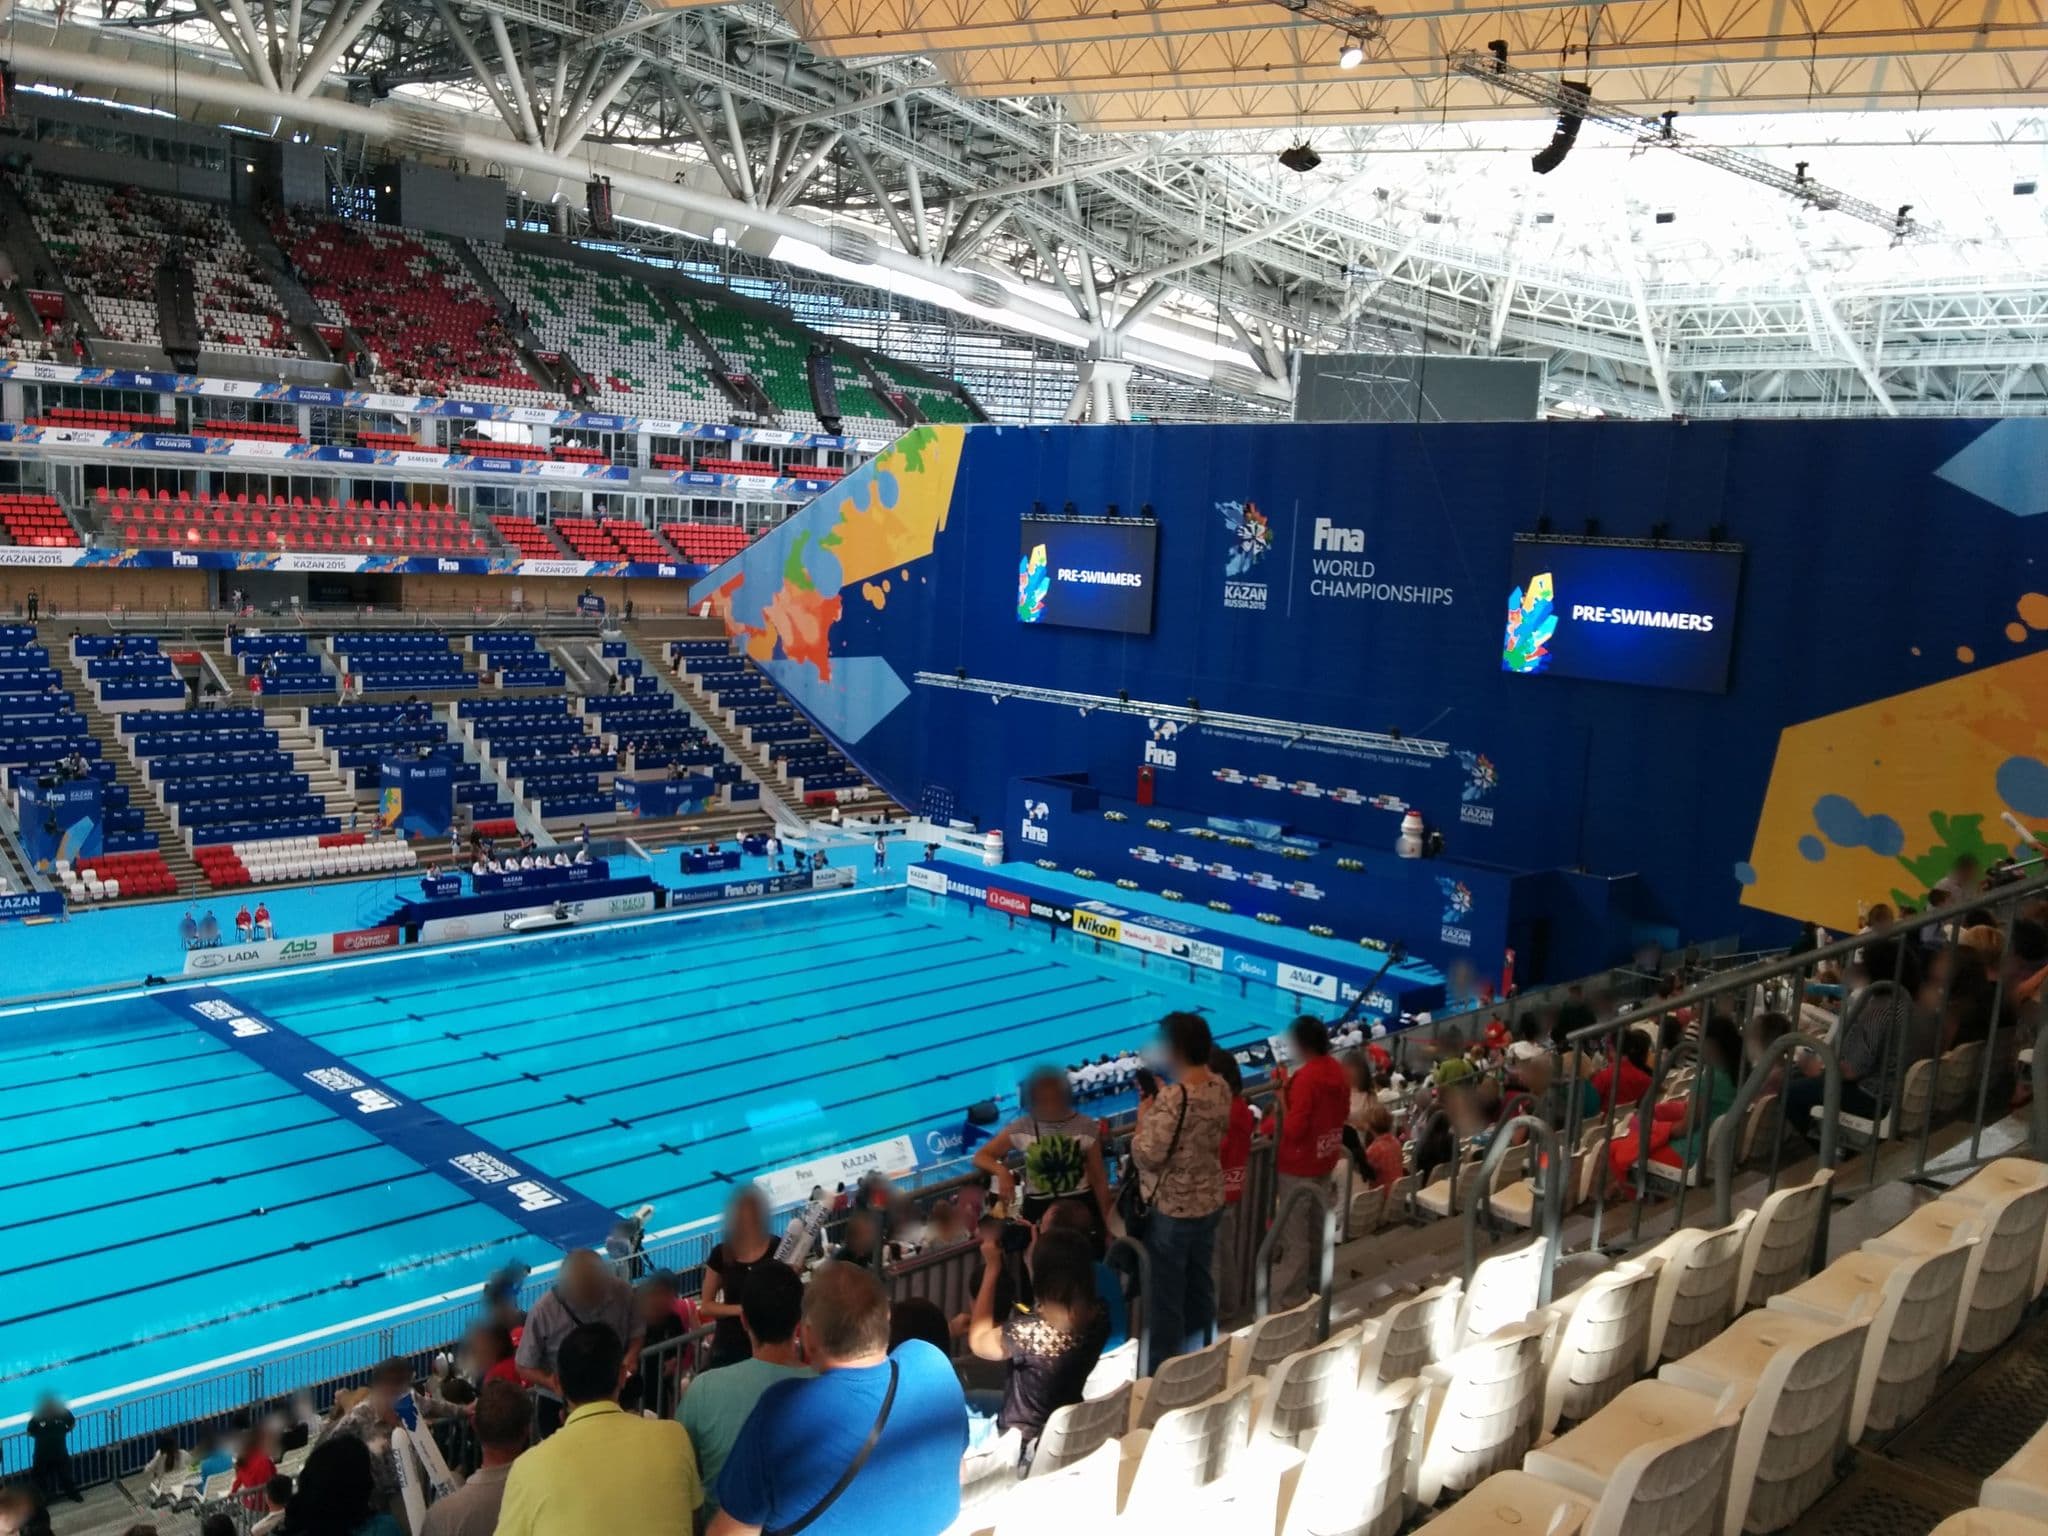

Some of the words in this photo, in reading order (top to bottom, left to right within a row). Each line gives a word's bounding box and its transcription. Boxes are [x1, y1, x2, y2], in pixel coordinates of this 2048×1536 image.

[135, 375, 152, 386] Fina
[223, 383, 238, 392] EF
[407, 455, 438, 464] SAMSUNG
[1314, 517, 1365, 552] Fina
[38, 556, 63, 565] 2015
[173, 552, 199, 566] Fina
[293, 561, 324, 569] KAZAN
[438, 558, 459, 571] Fina
[534, 566, 560, 574] KAZAN
[561, 566, 578, 574] 2015
[658, 564, 676, 576] Fina
[1313, 558, 1376, 578] WORLD
[1058, 568, 1142, 587] PRE-SWIMMERS
[1224, 585, 1267, 602] KAZAN
[1310, 579, 1454, 605] CHAMPIONSHIPS
[1224, 599, 1249, 609] RUSSIA
[1573, 604, 1714, 632] PRE-SWIMMERS
[1145, 740, 1176, 766] Fina
[1461, 806, 1494, 820] KAZAN
[1022, 819, 1048, 842] Fina
[947, 880, 987, 900] SAMSUNG
[999, 896, 1026, 911] OMEGA
[1077, 915, 1117, 938] Nikon
[1441, 928, 1470, 942] KAZAN
[228, 950, 259, 963] LADA
[1289, 969, 1313, 984] ANA
[841, 1152, 878, 1169] KAZAN
[507, 1180, 562, 1212] Fina
